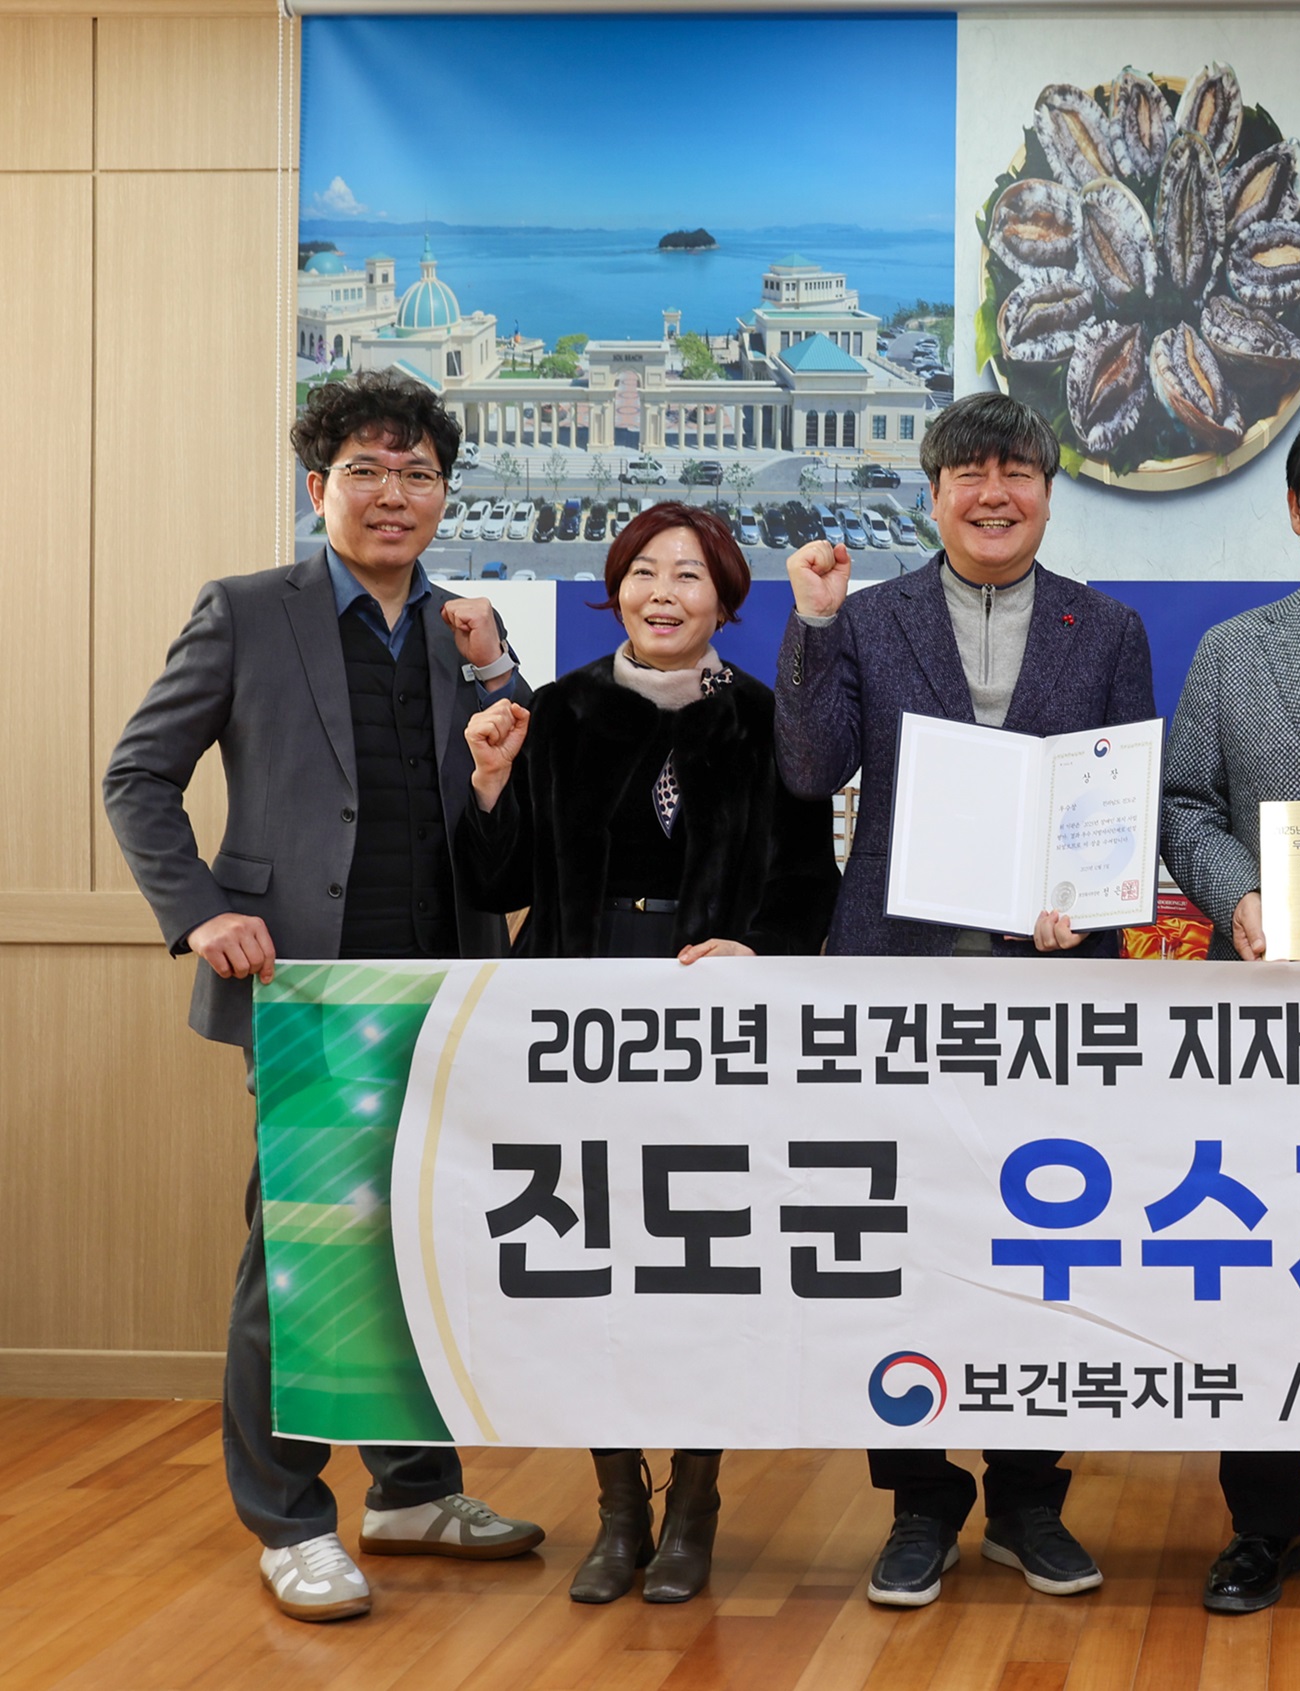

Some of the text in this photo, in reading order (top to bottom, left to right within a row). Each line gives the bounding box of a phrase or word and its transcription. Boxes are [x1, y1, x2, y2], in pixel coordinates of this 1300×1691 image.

[529, 1005, 768, 1085] 2025년
[797, 1003, 1143, 1086] 보건복지부
[485, 1140, 908, 1299] 진도군
[958, 1362, 1244, 1419] 보건복지부
